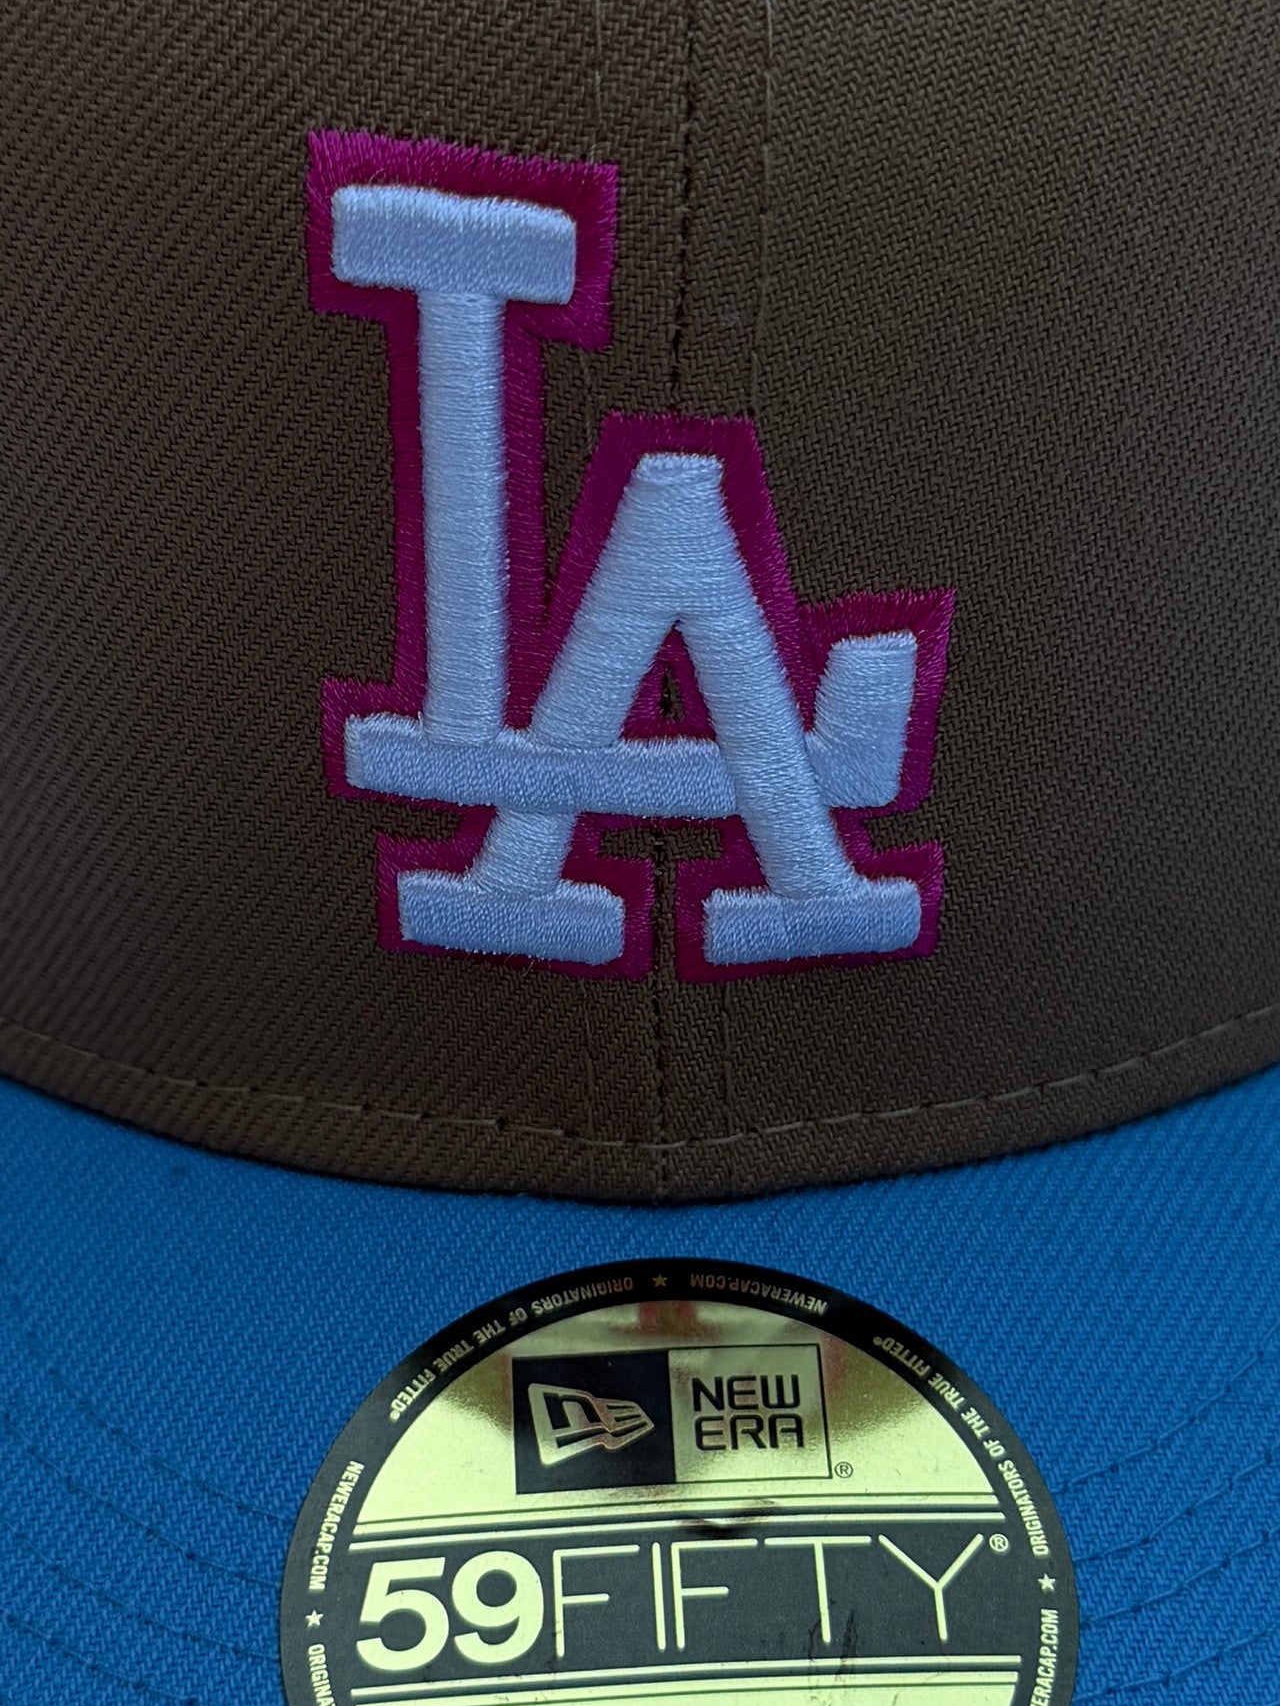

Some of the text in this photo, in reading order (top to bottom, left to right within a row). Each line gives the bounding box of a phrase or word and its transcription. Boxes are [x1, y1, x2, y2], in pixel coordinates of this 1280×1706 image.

[331, 183, 921, 967] LA
[531, 1276, 634, 1315] ORIGINATORS
[690, 1272, 828, 1316] NEWERACAP.COM
[472, 1319, 507, 1344] THE
[509, 1306, 528, 1327] OF
[432, 1338, 475, 1374] TRUE
[691, 1373, 801, 1412] NEW
[927, 1372, 966, 1411] TRUE
[693, 1412, 805, 1451] ERA
[960, 1407, 991, 1439] THE
[983, 1438, 1007, 1460] OF
[308, 1459, 366, 1592] NEWERACAP.COM
[998, 1459, 1051, 1558] ORIGINATORS
